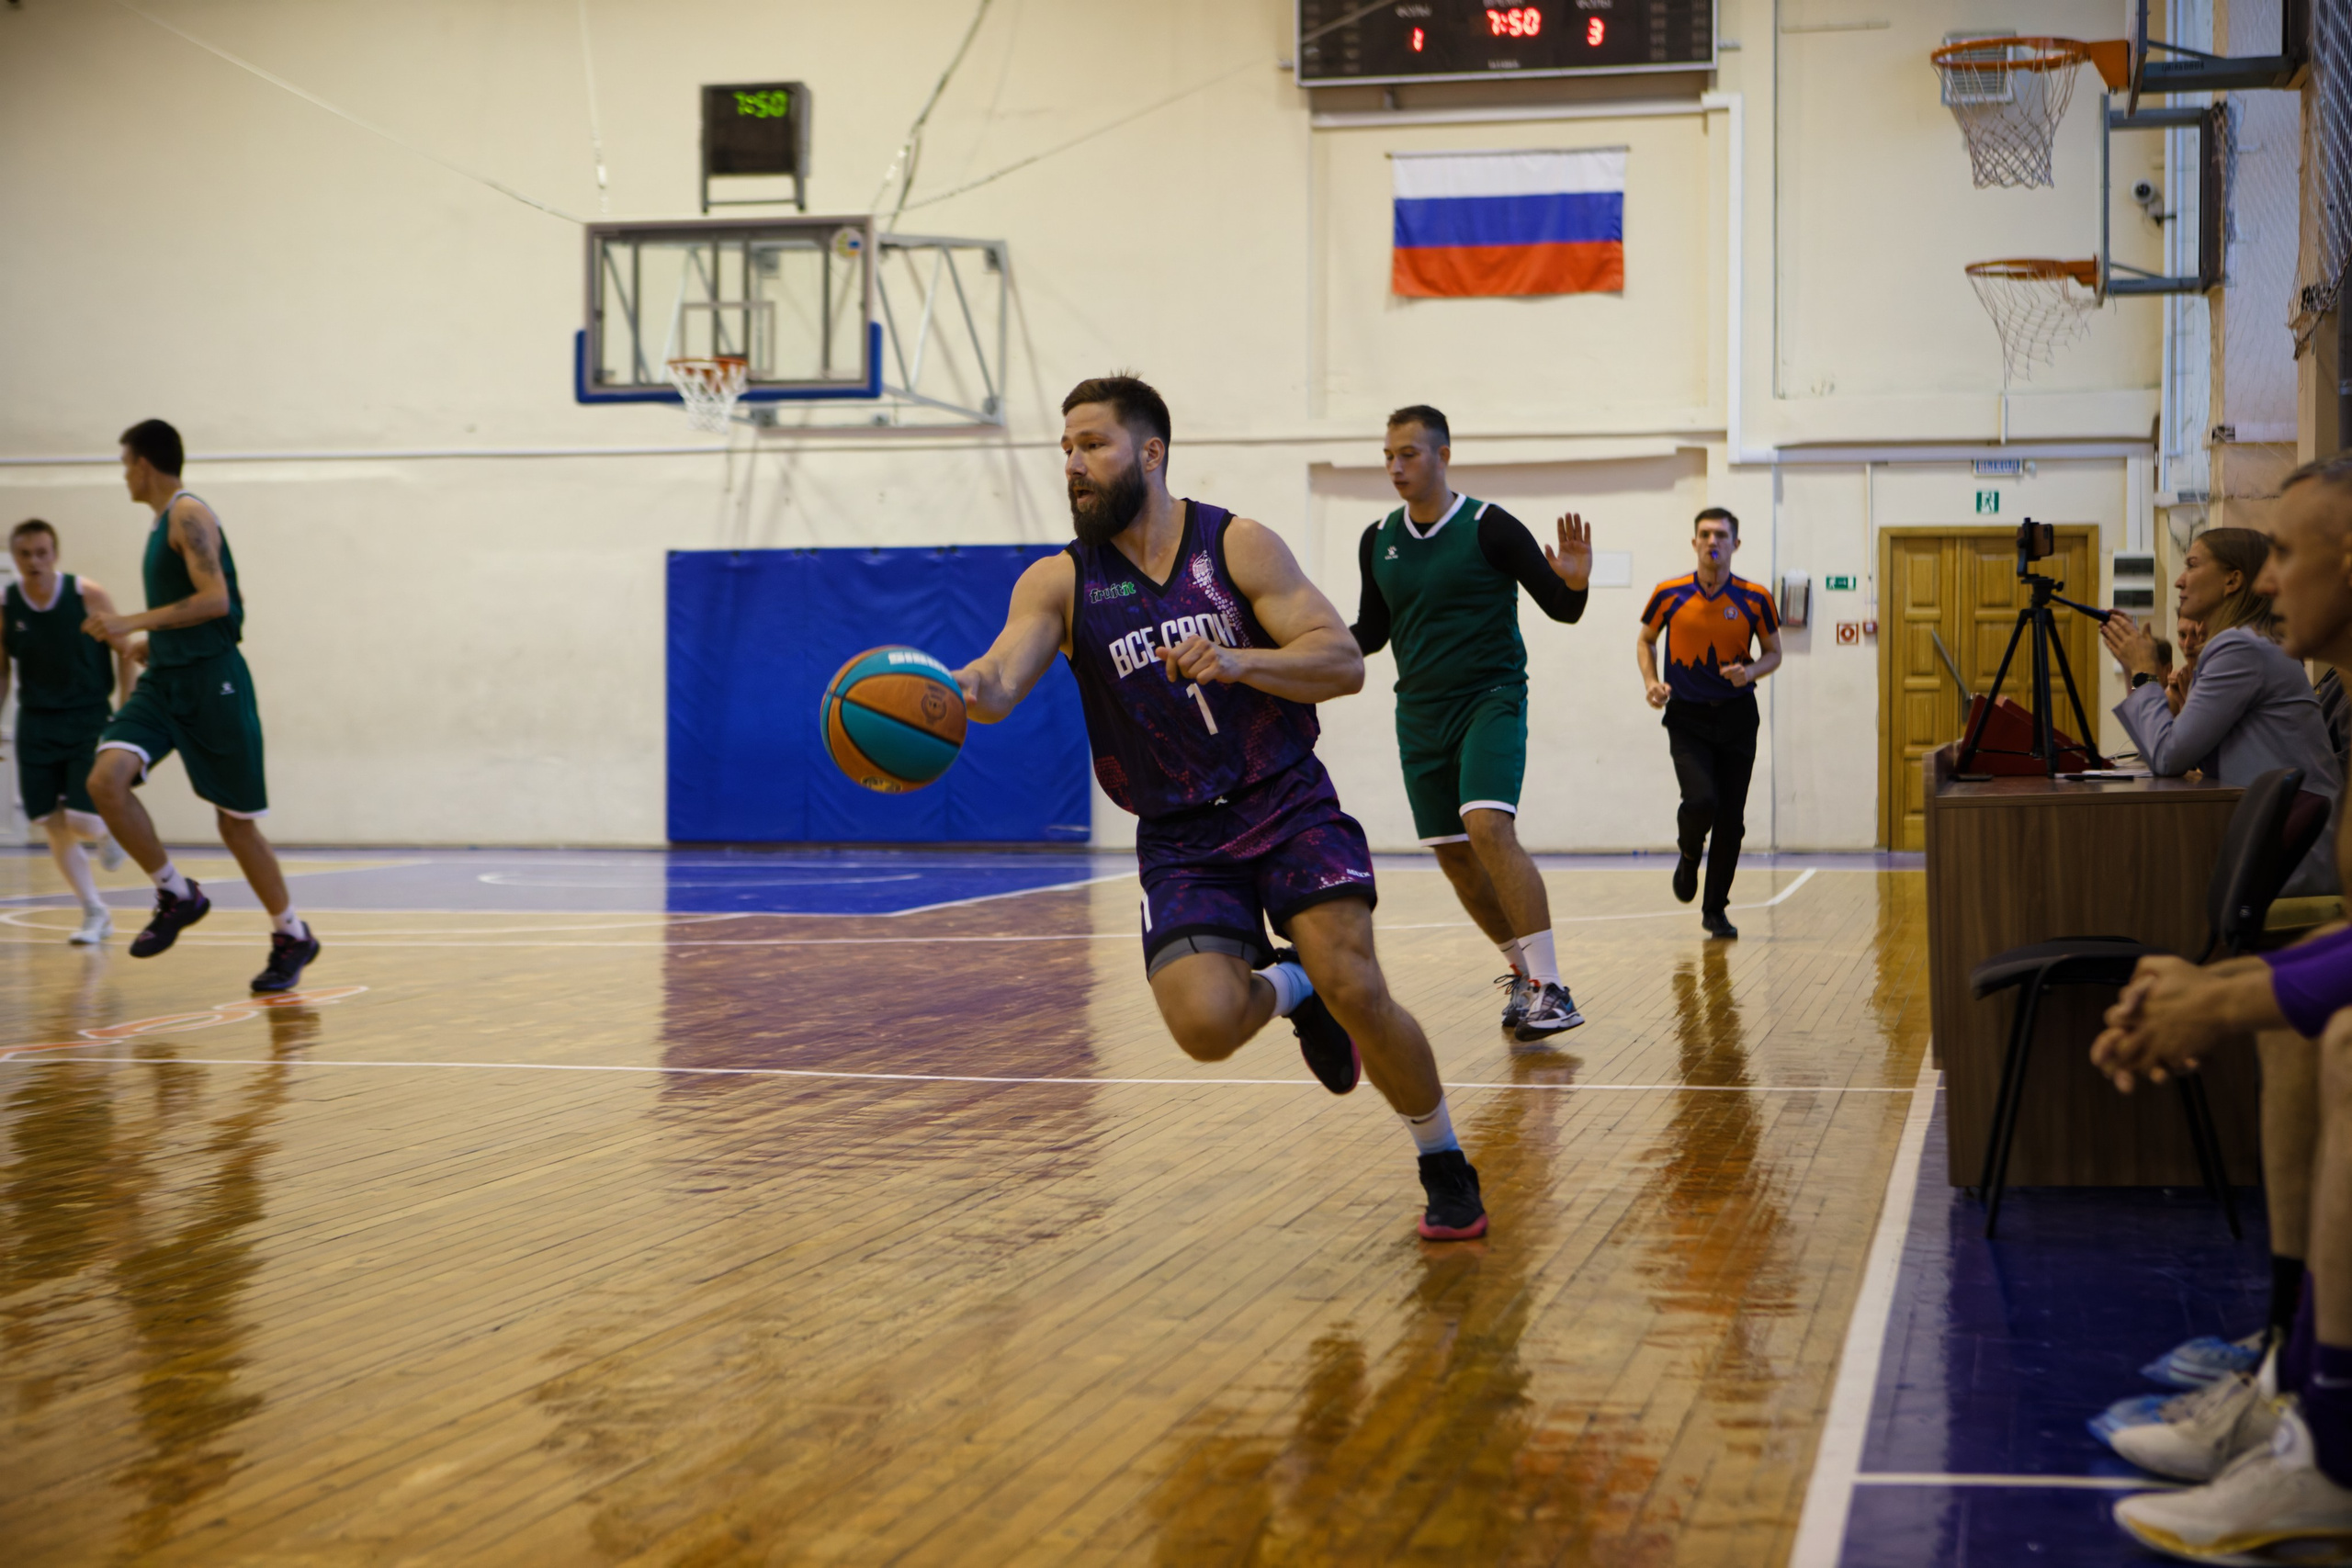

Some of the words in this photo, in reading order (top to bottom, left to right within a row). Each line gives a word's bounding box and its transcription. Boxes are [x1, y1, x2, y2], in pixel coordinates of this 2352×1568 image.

[1487, 7, 1542, 37] 7:50
[1587, 17, 1605, 47] 3
[1412, 27, 1425, 52] 1
[1185, 682, 1219, 736] 1
